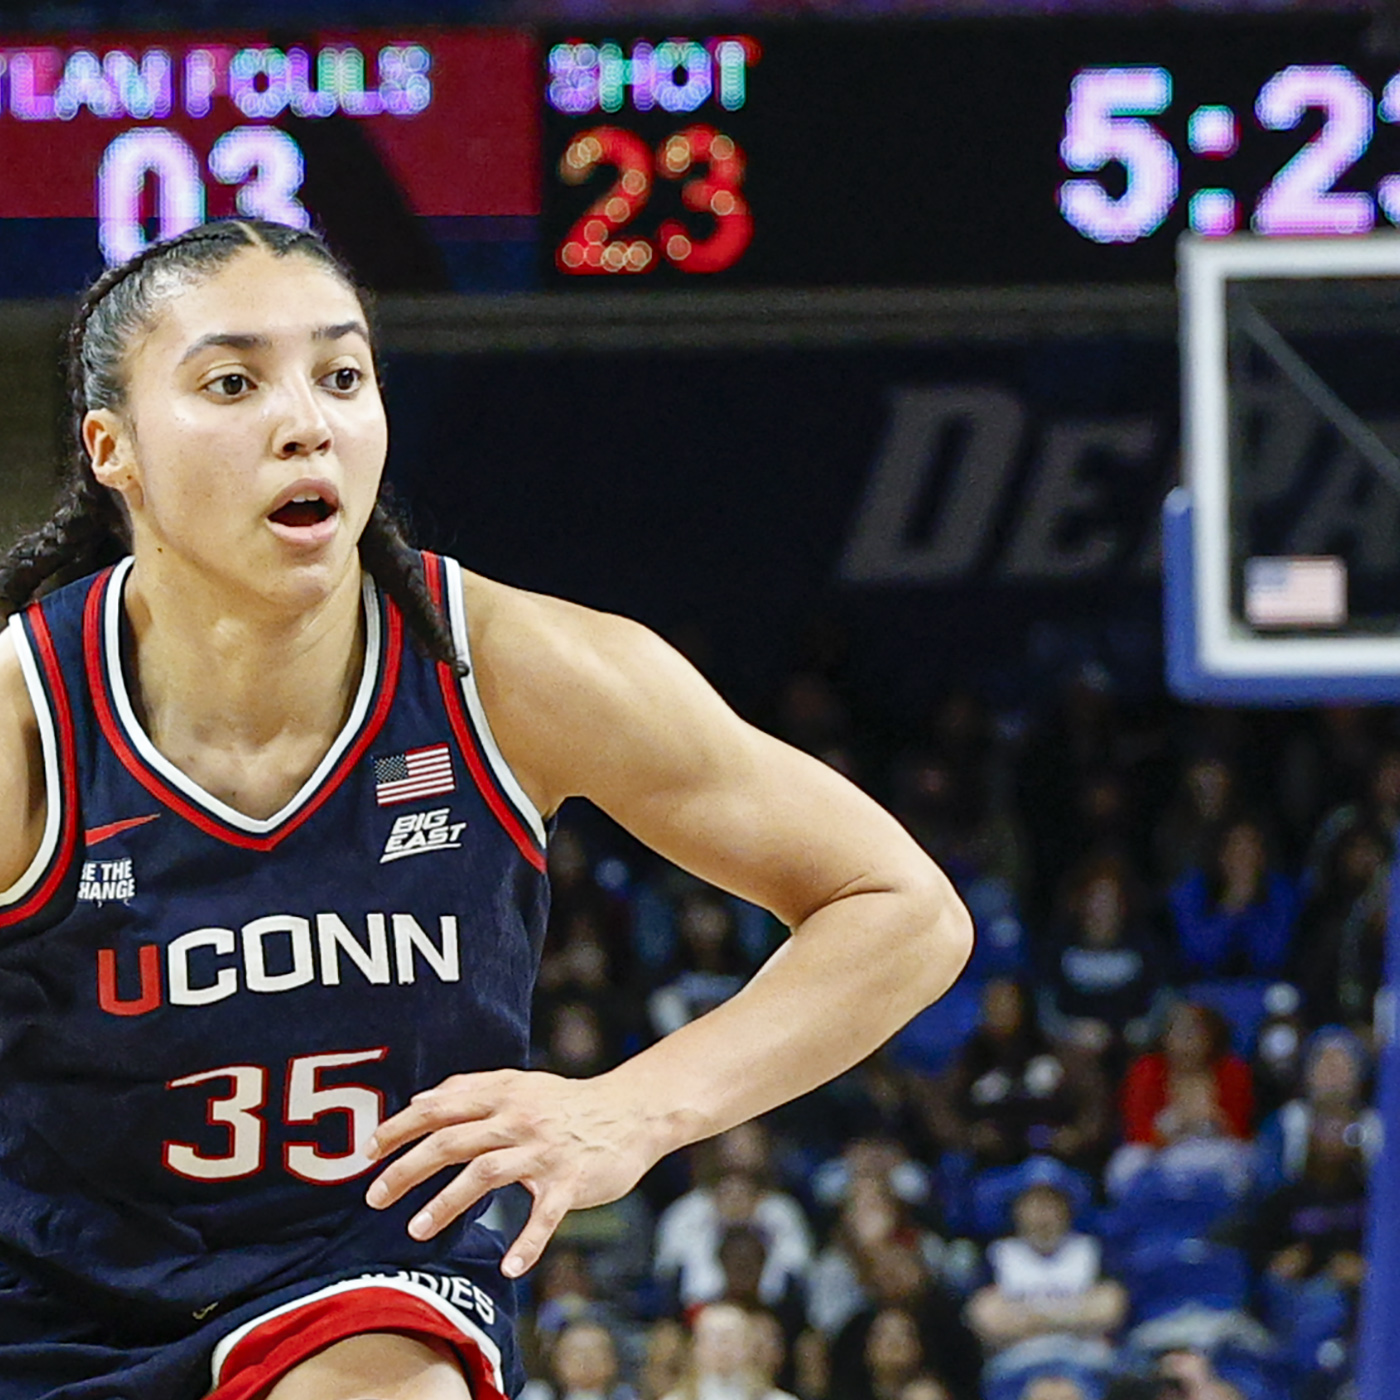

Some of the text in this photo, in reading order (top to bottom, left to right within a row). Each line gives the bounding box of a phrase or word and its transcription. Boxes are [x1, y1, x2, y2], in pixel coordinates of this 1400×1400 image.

[183, 45, 433, 119] FOULS
[549, 38, 761, 114] SHOT
[97, 126, 310, 270] 03
[555, 124, 755, 275] 23
[384, 822, 467, 853] EAST
[391, 807, 451, 835] BIG
[77, 878, 135, 900] HANGE
[100, 858, 132, 881] THE
[97, 913, 460, 1016] UCONN
[162, 1045, 390, 1186] 35
